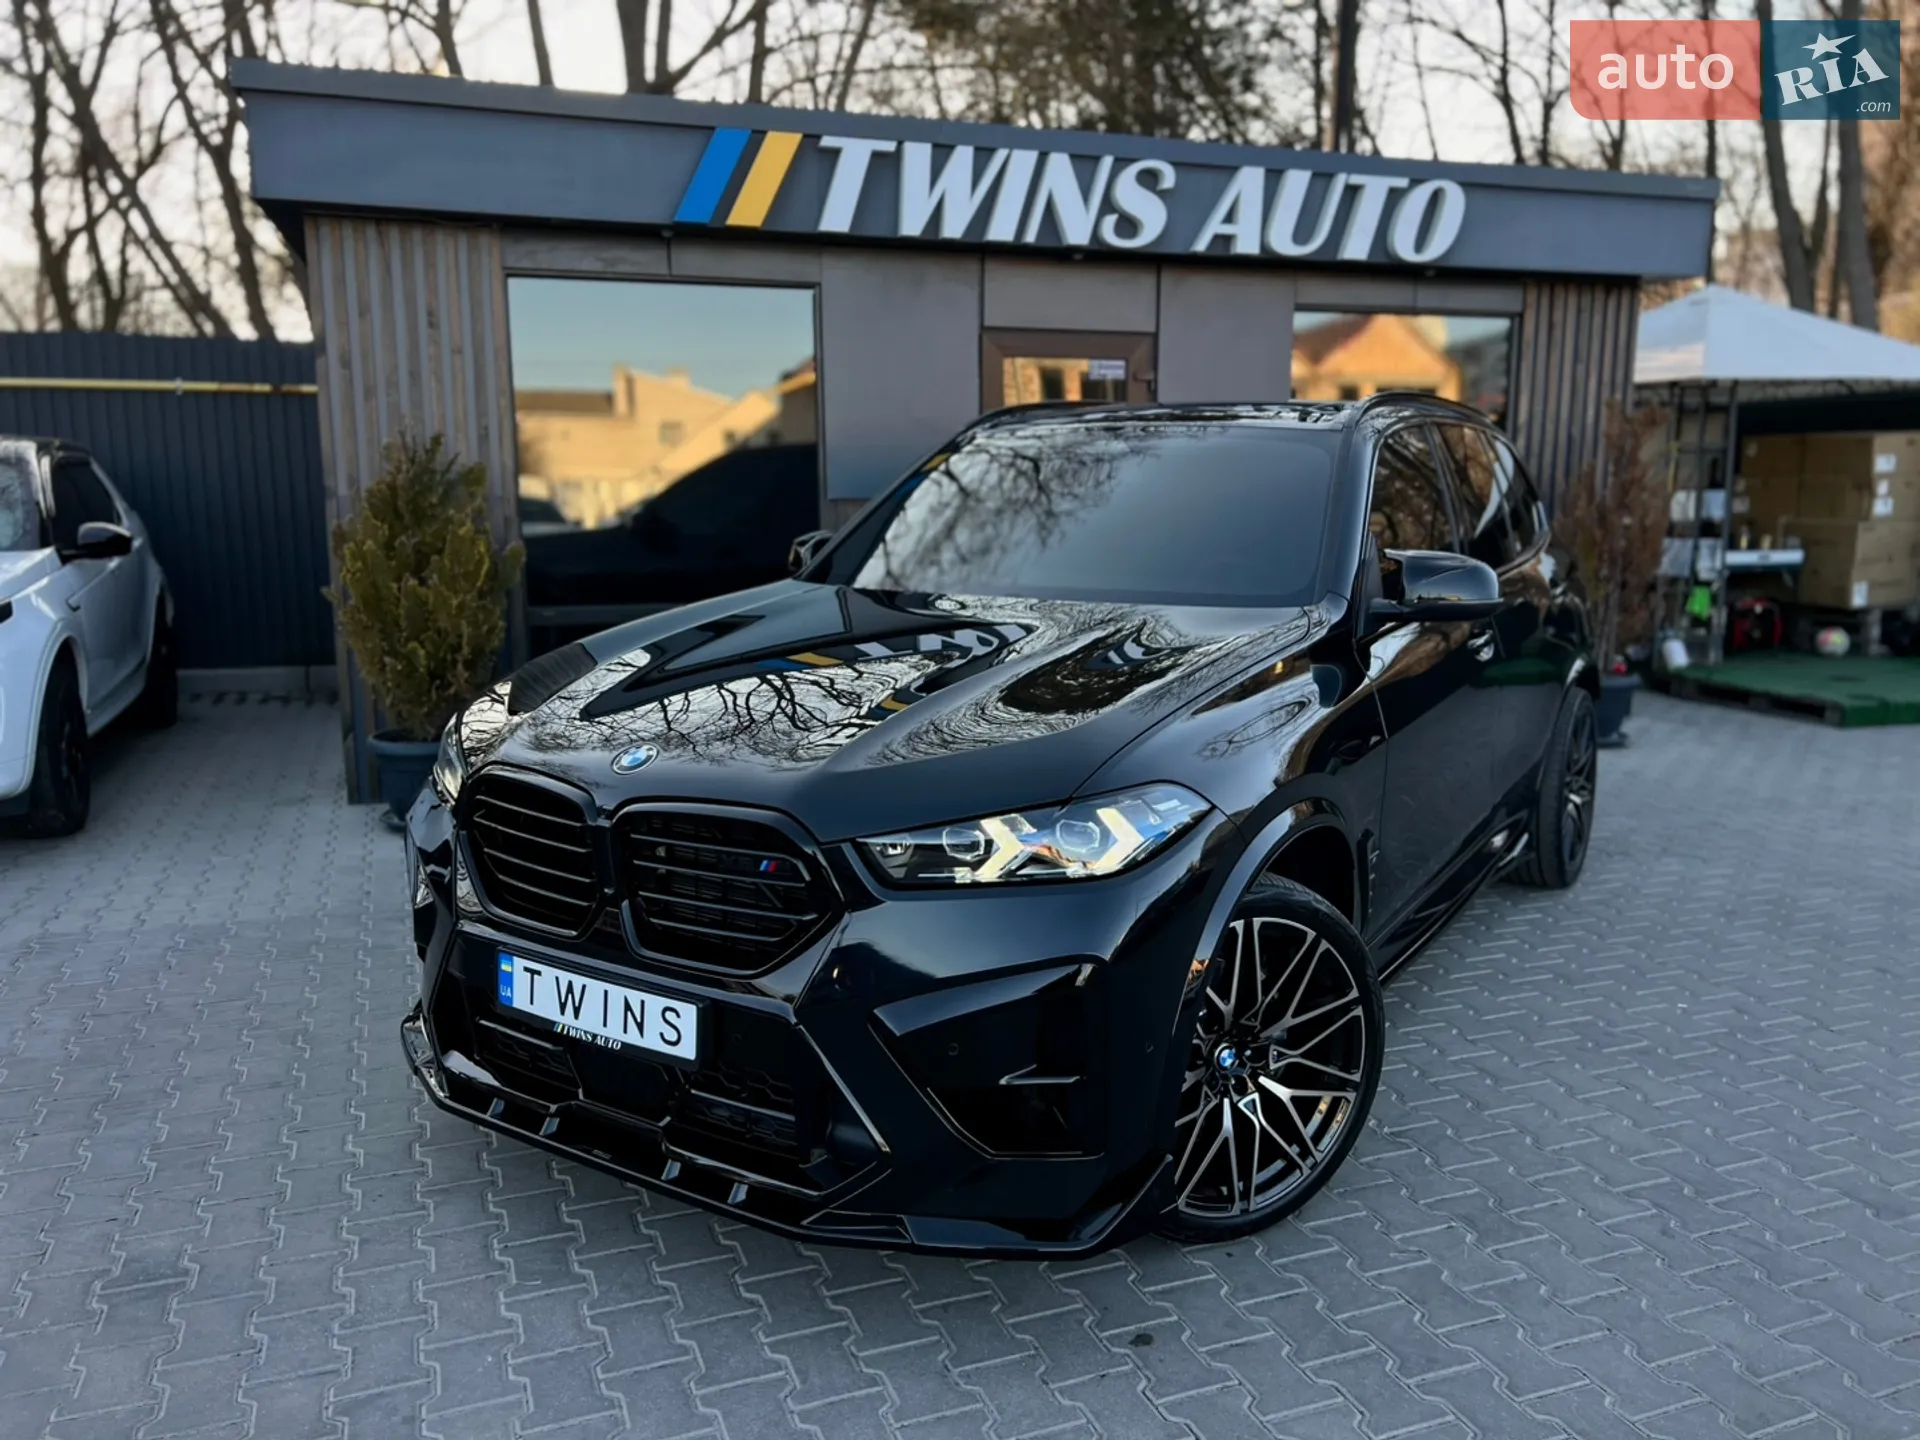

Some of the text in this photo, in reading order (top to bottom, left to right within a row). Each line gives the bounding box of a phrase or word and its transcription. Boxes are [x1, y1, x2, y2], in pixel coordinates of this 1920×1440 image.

[817, 134, 1466, 264] TWINS AUTO
[500, 986, 512, 998] UA
[523, 966, 682, 1047] TWINS
[562, 1025, 622, 1050] TWINS AUTO
